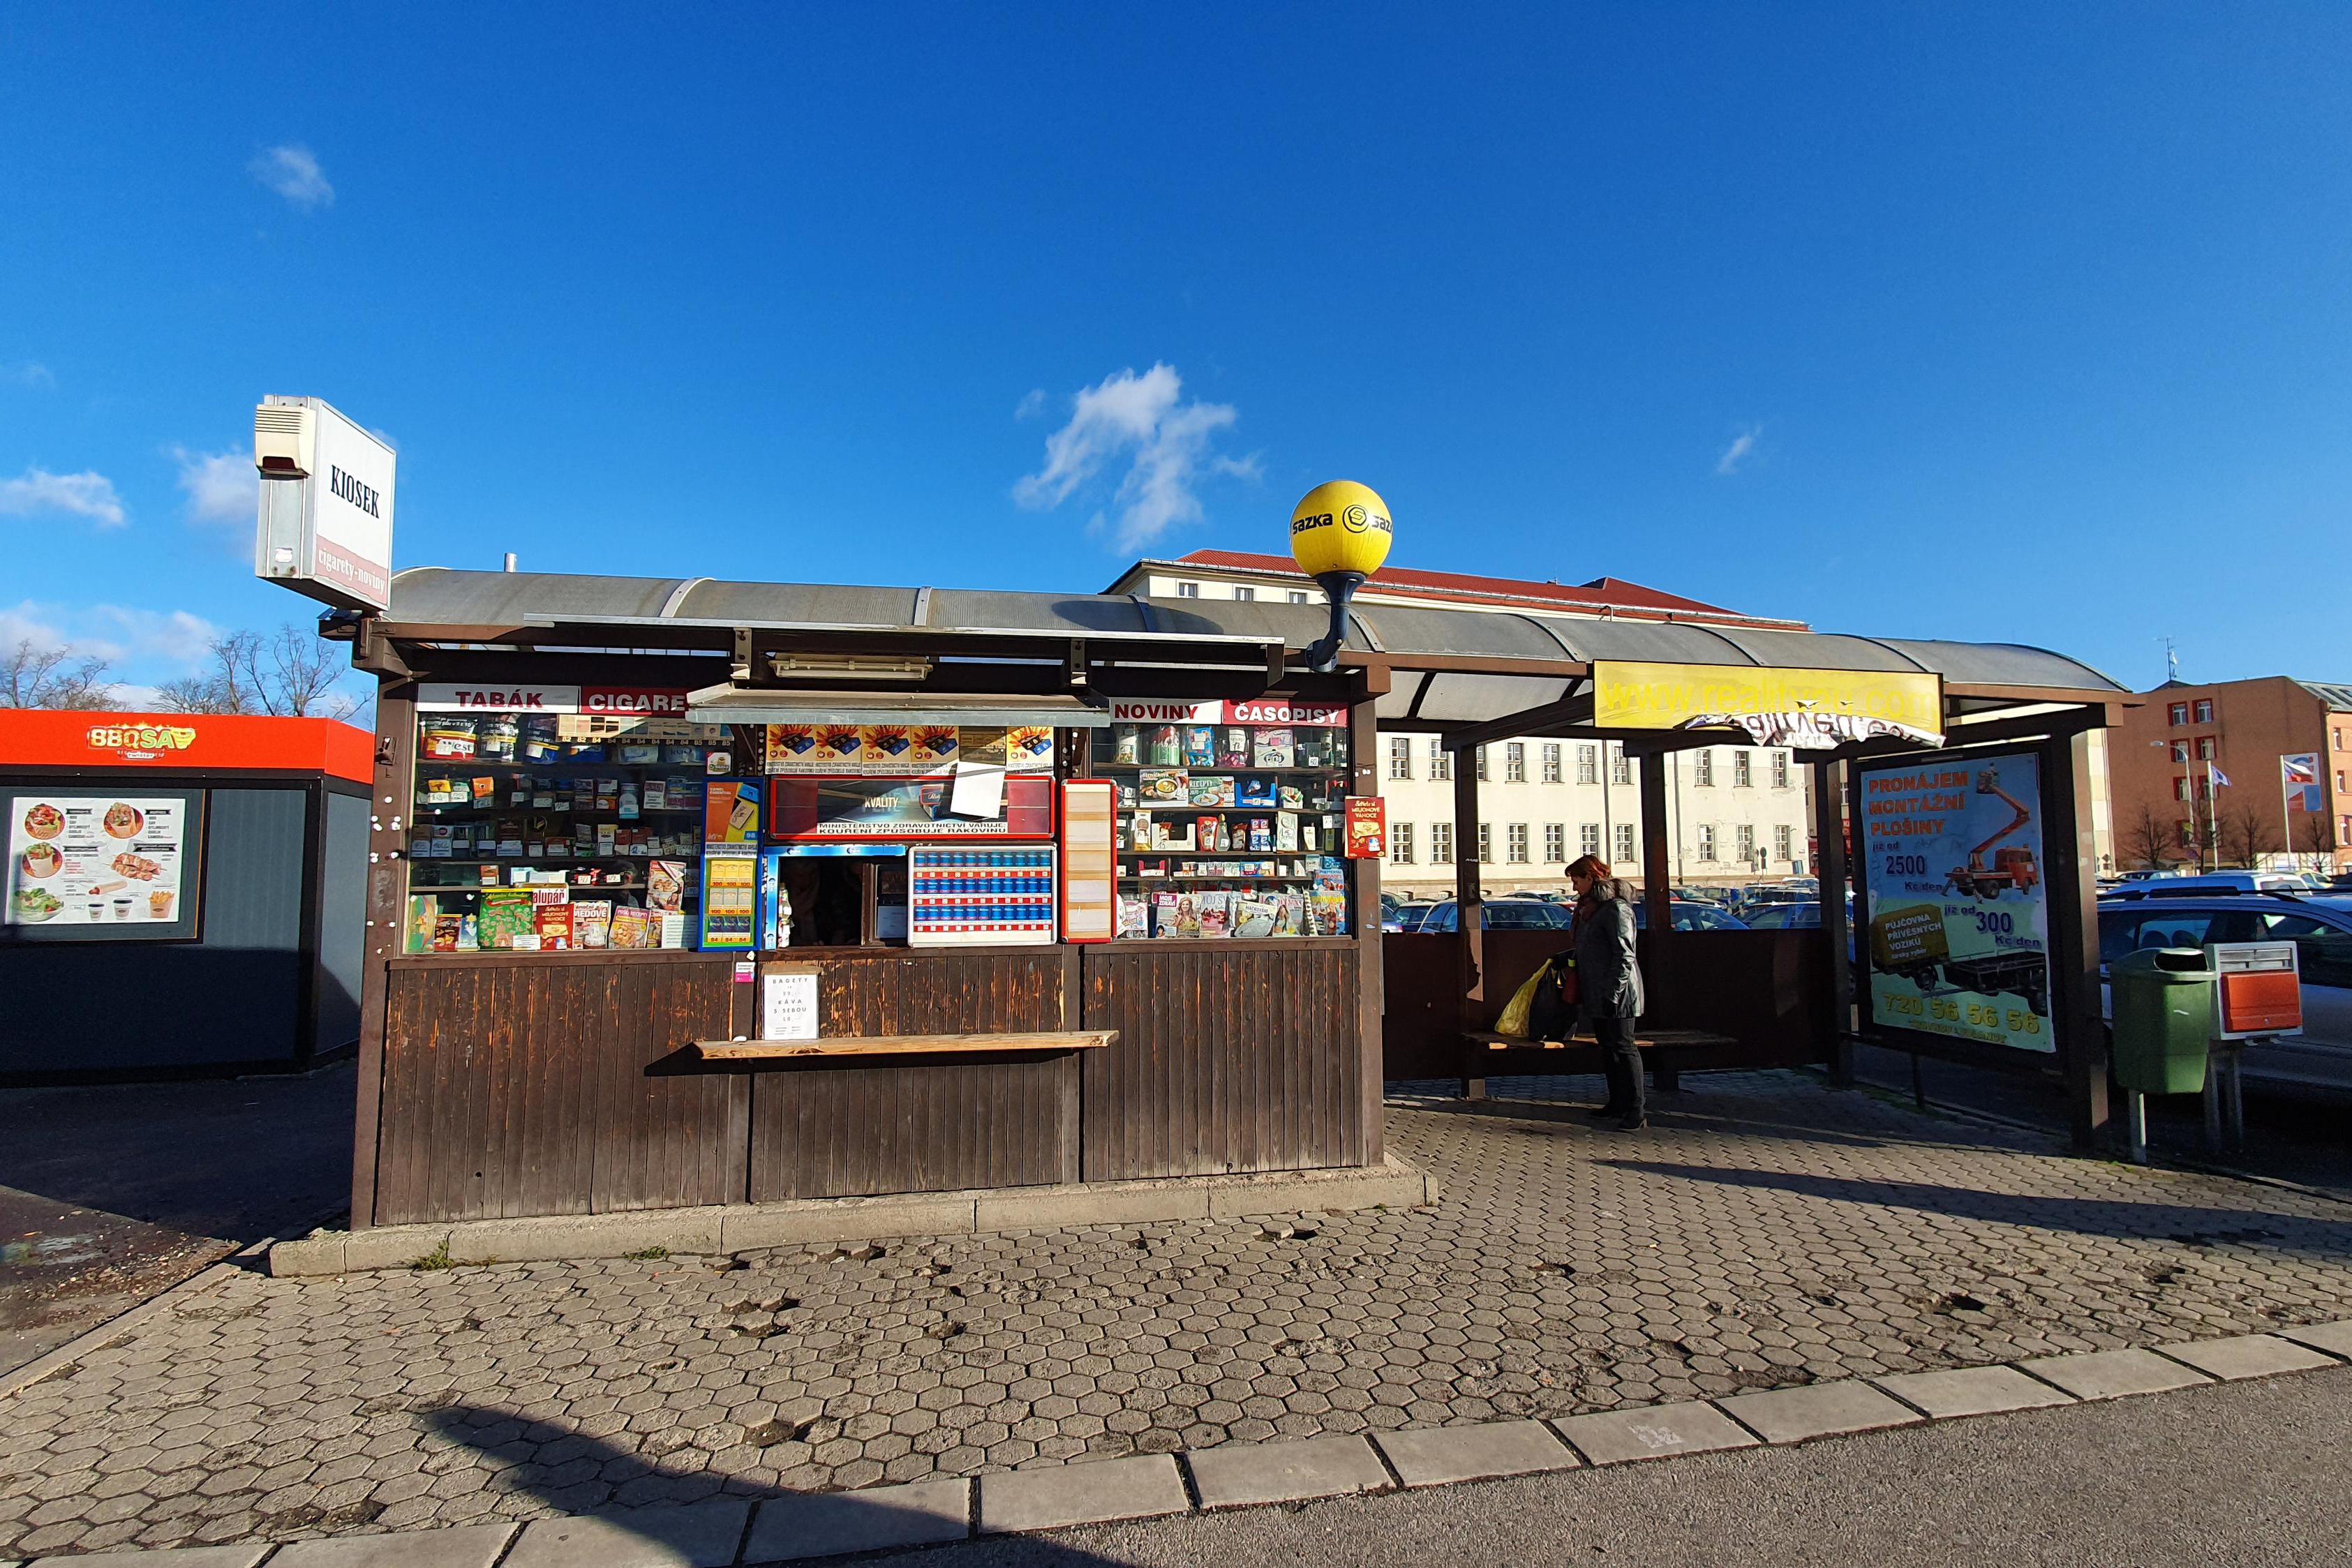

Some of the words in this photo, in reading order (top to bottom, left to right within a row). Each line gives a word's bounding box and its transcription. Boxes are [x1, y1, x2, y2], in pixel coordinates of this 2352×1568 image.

[331, 465, 379, 518] KIOSEK
[1293, 513, 1333, 535] sazka
[455, 689, 543, 708] TABÁK
[588, 694, 685, 711] CIGARE
[1115, 704, 1198, 719] NOVINY
[1235, 702, 1339, 724] ČASOPISY
[1869, 770, 1969, 794] PRONÁJEM
[864, 797, 899, 808] KVALITY
[1869, 791, 1965, 815] MONTÁŽNÍ
[1870, 817, 1945, 836] PLOŠINY
[1886, 842, 1898, 850] od
[1886, 855, 1926, 876] 2500
[1960, 906, 1975, 916] od
[1976, 911, 2013, 933] 300
[1883, 993, 1923, 1015] 720
[1930, 998, 1960, 1022] 56
[1966, 1004, 1999, 1028] 56
[2006, 1008, 2039, 1035] 56
